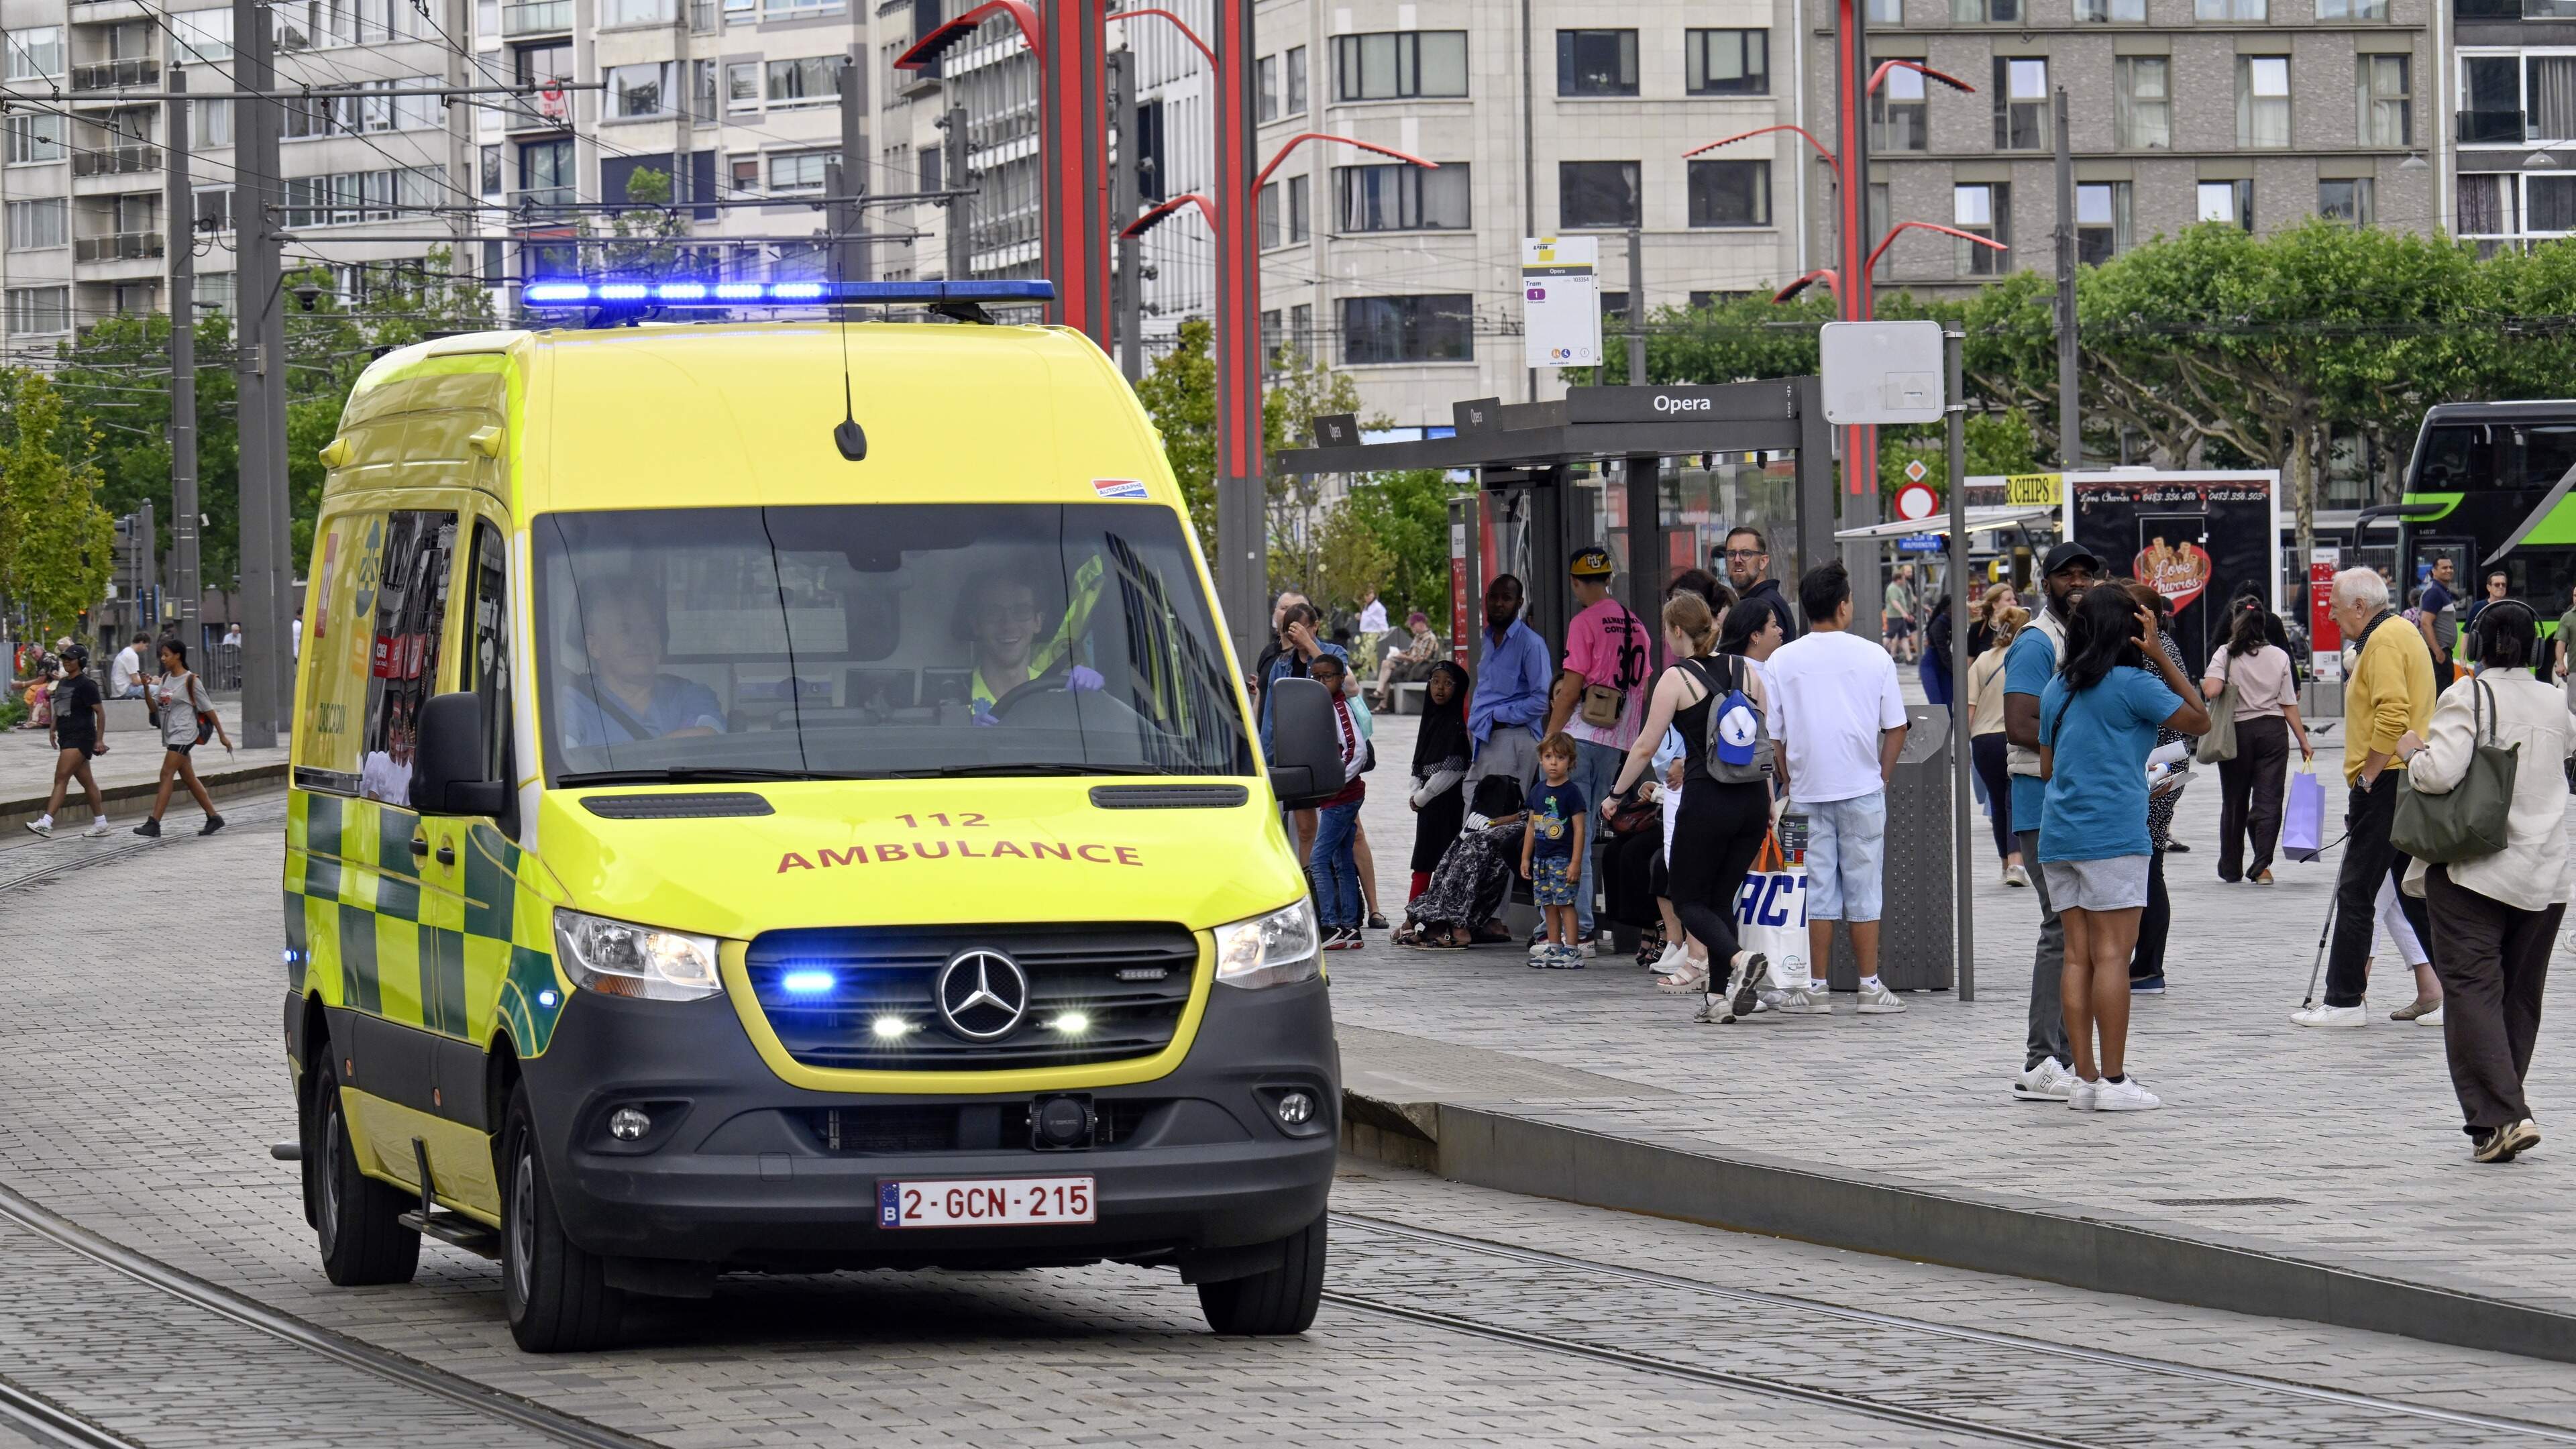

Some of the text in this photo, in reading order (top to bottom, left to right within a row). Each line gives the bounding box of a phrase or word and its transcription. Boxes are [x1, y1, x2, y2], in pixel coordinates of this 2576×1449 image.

[1654, 395, 1711, 415] Opera
[1470, 408, 1483, 427] Opera
[1099, 482, 1144, 495] AUTOGRAPHE
[2015, 477, 2049, 503] CHIPS
[2079, 493, 2099, 502] Love
[2102, 492, 2130, 502] Churros
[1586, 554, 1601, 569] MU
[2154, 558, 2192, 578] Love
[2149, 577, 2199, 593] Churros
[895, 813, 990, 828] 112
[777, 841, 1144, 873] AMBULANCE
[884, 1185, 1087, 1221] B 2-GCN-215
